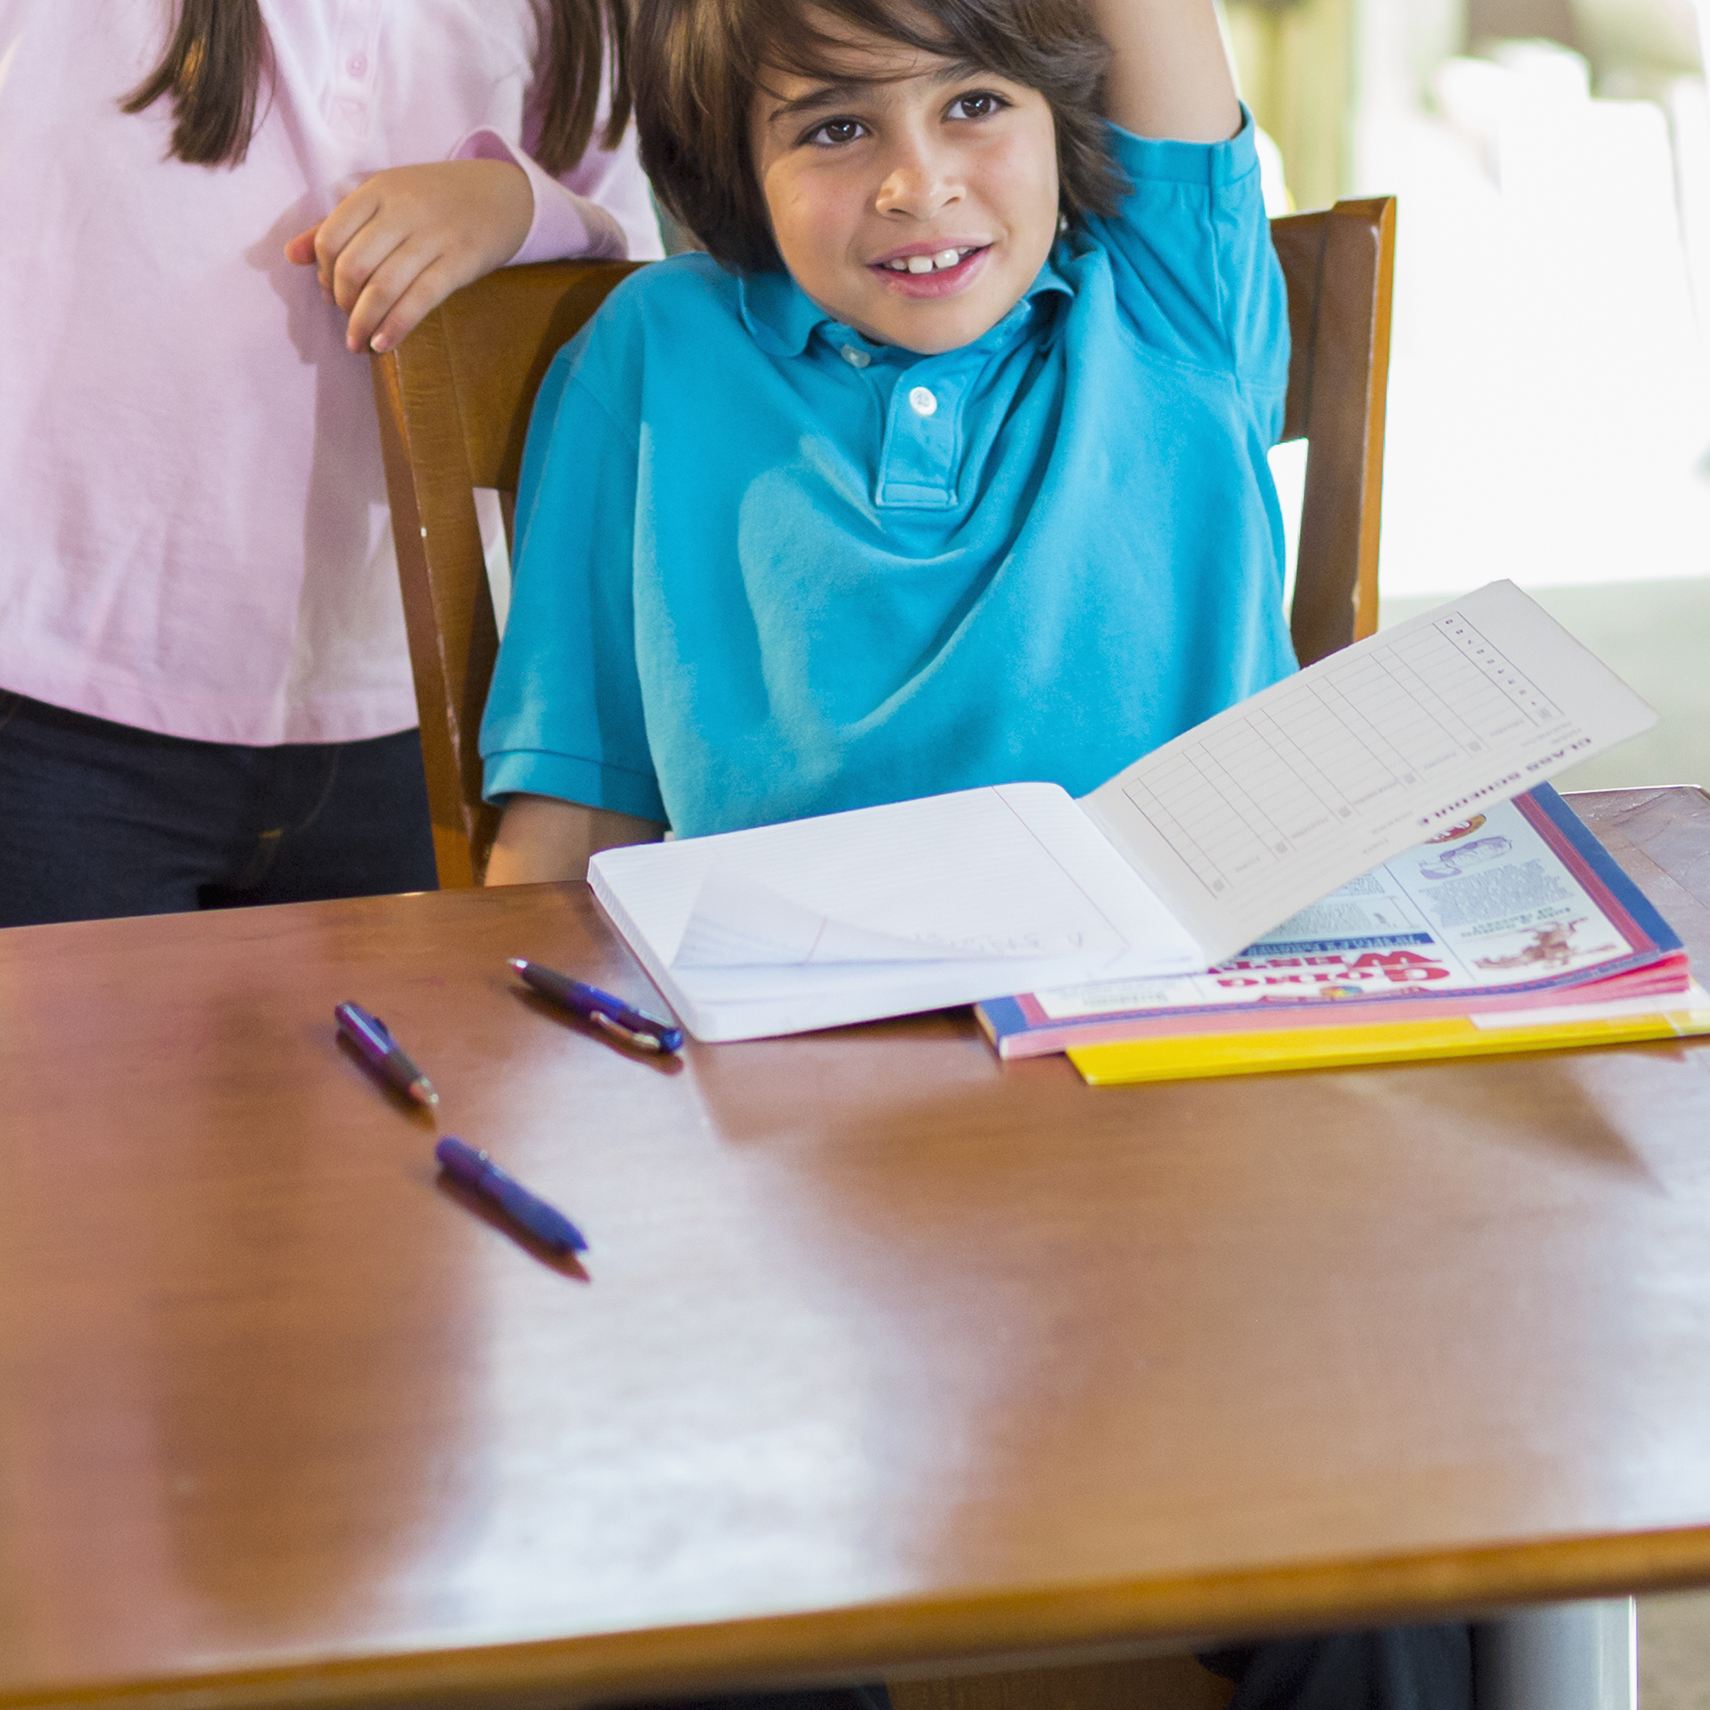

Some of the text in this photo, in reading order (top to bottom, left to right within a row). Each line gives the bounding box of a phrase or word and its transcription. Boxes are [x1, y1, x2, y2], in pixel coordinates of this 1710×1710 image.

[1526, 738, 1592, 772] CLASS
[1418, 770, 1522, 827] SCHEDULE
[1216, 966, 1451, 988] GOING
